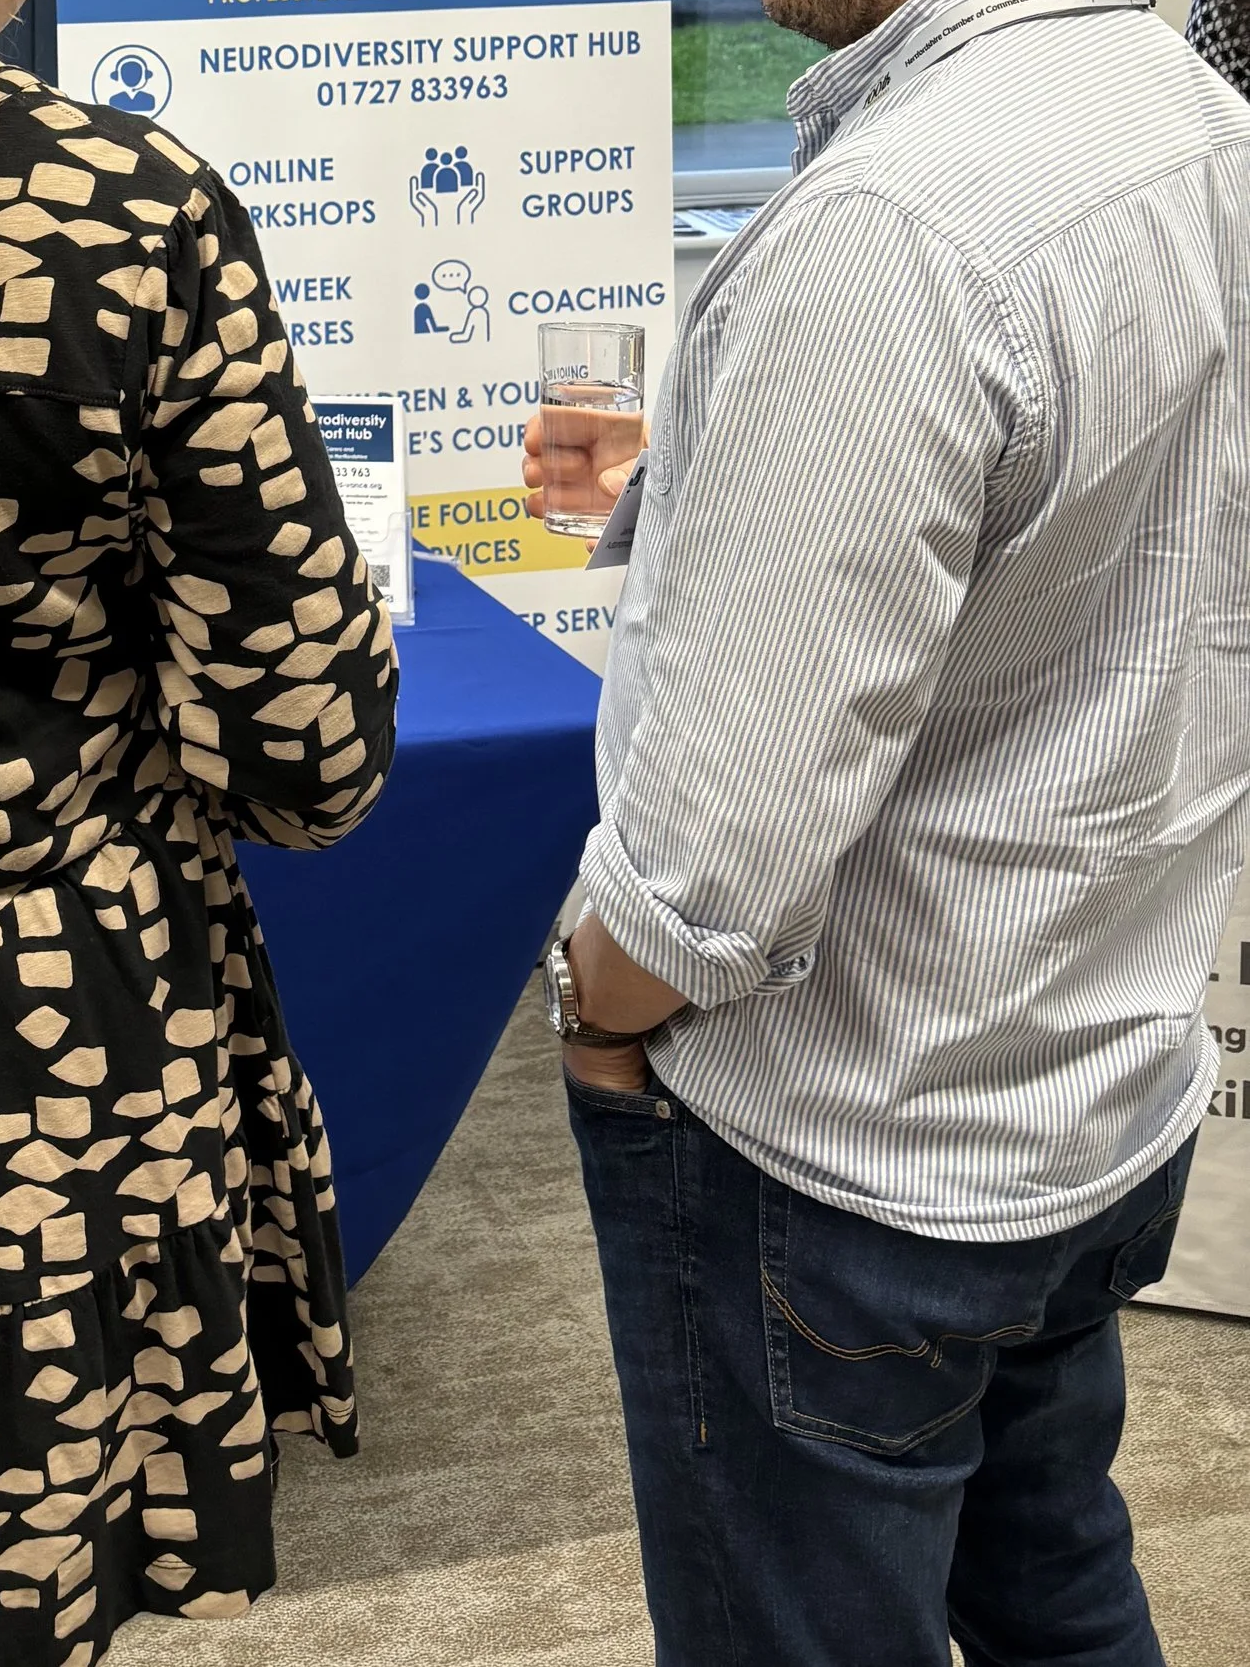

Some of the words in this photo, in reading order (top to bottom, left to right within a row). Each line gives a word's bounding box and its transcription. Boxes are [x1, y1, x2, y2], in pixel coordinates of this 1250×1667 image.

[942, 14, 974, 36] Chamber
[976, 9, 985, 19] of
[200, 38, 442, 74] NEURODIVERSITY
[453, 33, 578, 64] SUPPORT
[588, 30, 641, 56] HUB
[317, 80, 401, 106] 01727
[411, 74, 508, 102] 833963
[230, 158, 334, 186] ONLINE
[519, 146, 635, 175] SUPPORT
[250, 200, 376, 229] RKSHOPS
[522, 189, 634, 218] GROUPS
[276, 276, 352, 303] WEEK
[509, 282, 666, 315] COACHING
[291, 320, 354, 347] RSES
[456, 387, 473, 409] &
[483, 380, 539, 407] YOU
[319, 414, 387, 429] rodiversity
[345, 428, 372, 440] Hub
[335, 467, 347, 477] 33
[351, 467, 371, 477] 963
[440, 497, 530, 527] FOLLO
[430, 538, 521, 566] VICES
[555, 604, 618, 633] SERV
